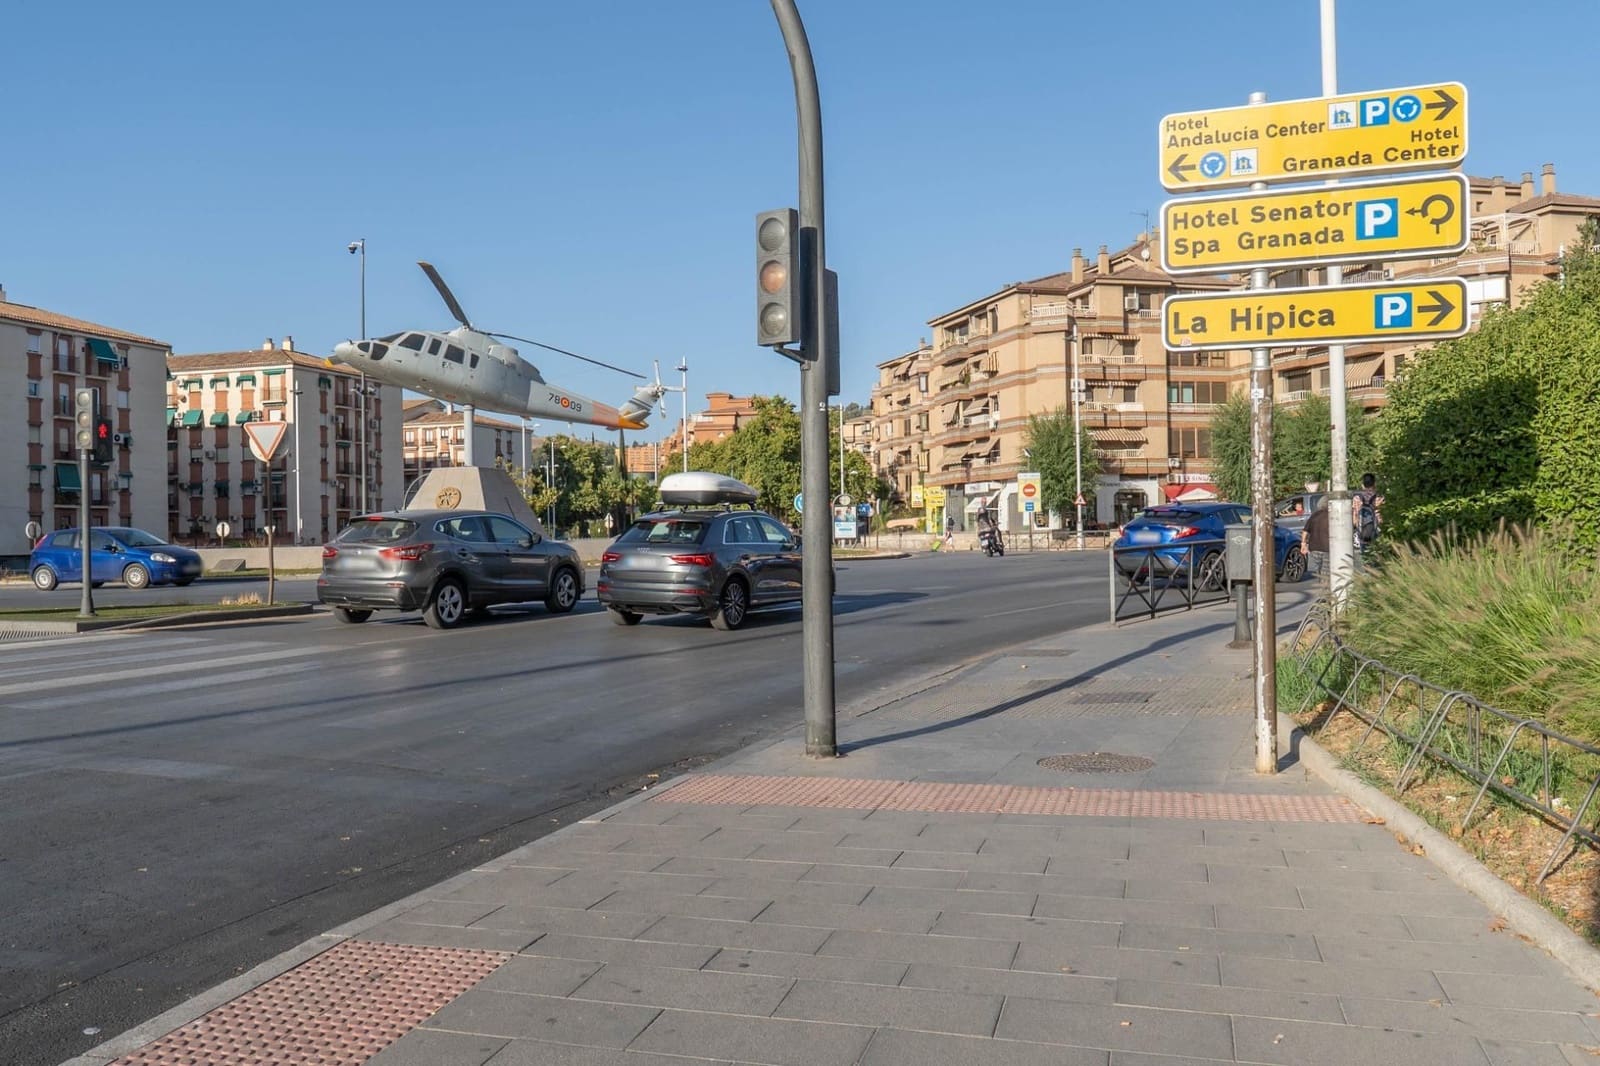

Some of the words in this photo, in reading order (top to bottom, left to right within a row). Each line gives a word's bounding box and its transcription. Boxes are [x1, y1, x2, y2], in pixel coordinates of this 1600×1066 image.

[1166, 116, 1209, 132] Hotel
[1366, 100, 1386, 125] P
[1167, 126, 1259, 149] Andalucía
[1266, 120, 1325, 139] Center
[1411, 126, 1459, 142] Hotel
[1283, 151, 1373, 172] Granada
[1384, 144, 1459, 163] Center
[1173, 207, 1239, 231] Hotel
[1250, 199, 1353, 224] Senator
[1364, 203, 1393, 237] P
[1174, 237, 1220, 259] Spa
[1237, 226, 1345, 250] Granada
[1173, 311, 1208, 335] La
[1230, 304, 1336, 336] Hípica
[1382, 297, 1408, 326] P
[548, 392, 560, 404] 78
